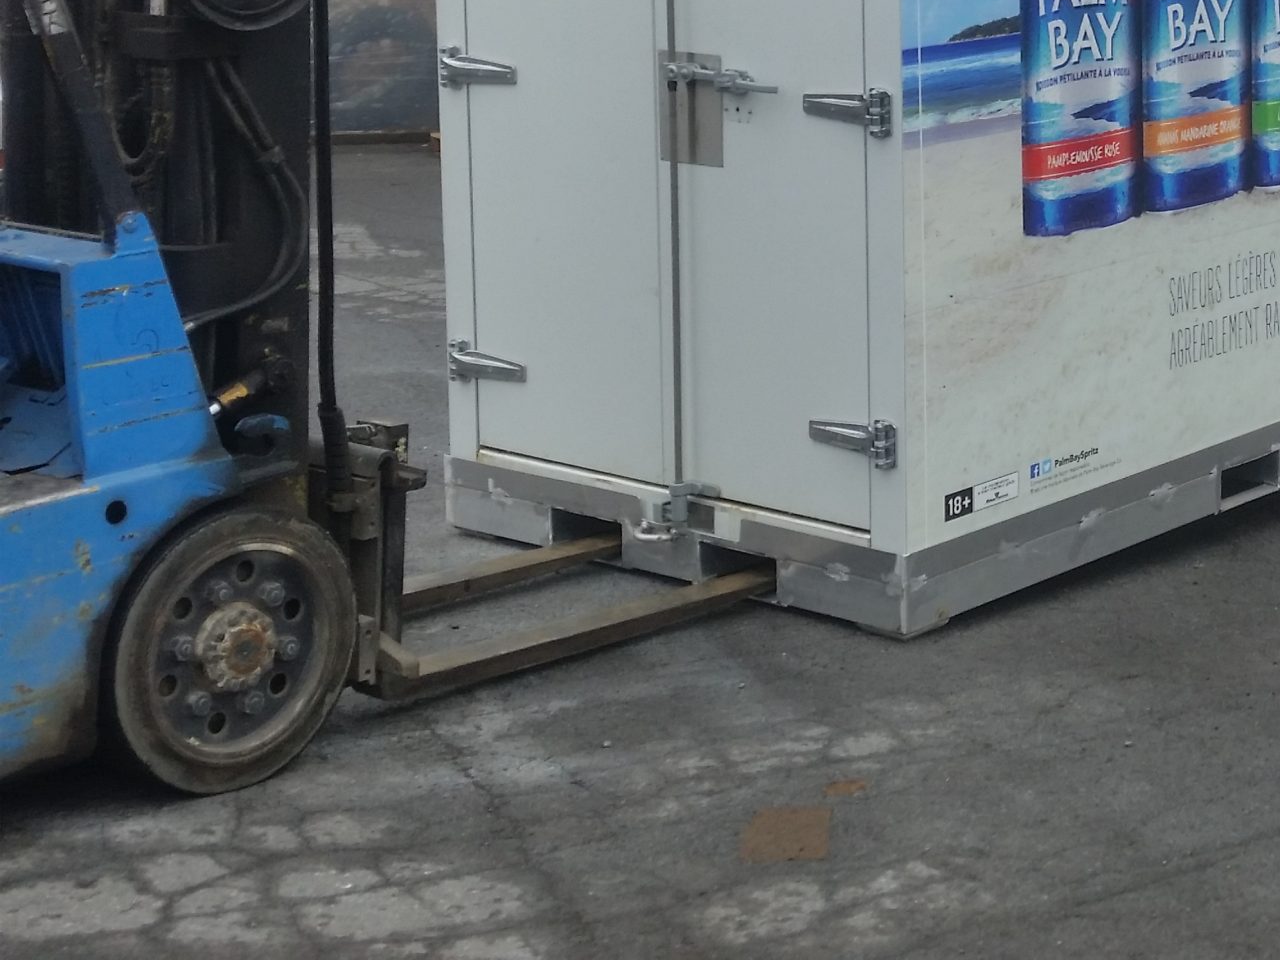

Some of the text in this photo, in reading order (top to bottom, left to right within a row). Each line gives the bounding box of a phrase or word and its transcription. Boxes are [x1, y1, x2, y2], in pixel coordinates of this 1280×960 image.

[1048, 11, 1123, 70] BAY
[1047, 141, 1121, 169] PAMPLEMOUSSE ROSE
[1169, 264, 1223, 317] SAVEURS
[1228, 250, 1276, 299] LÉGÈRES
[1169, 306, 1260, 370] AGRÉABLEMENT
[1054, 447, 1099, 469] PalmBaySpritz
[947, 494, 972, 516] 18+
